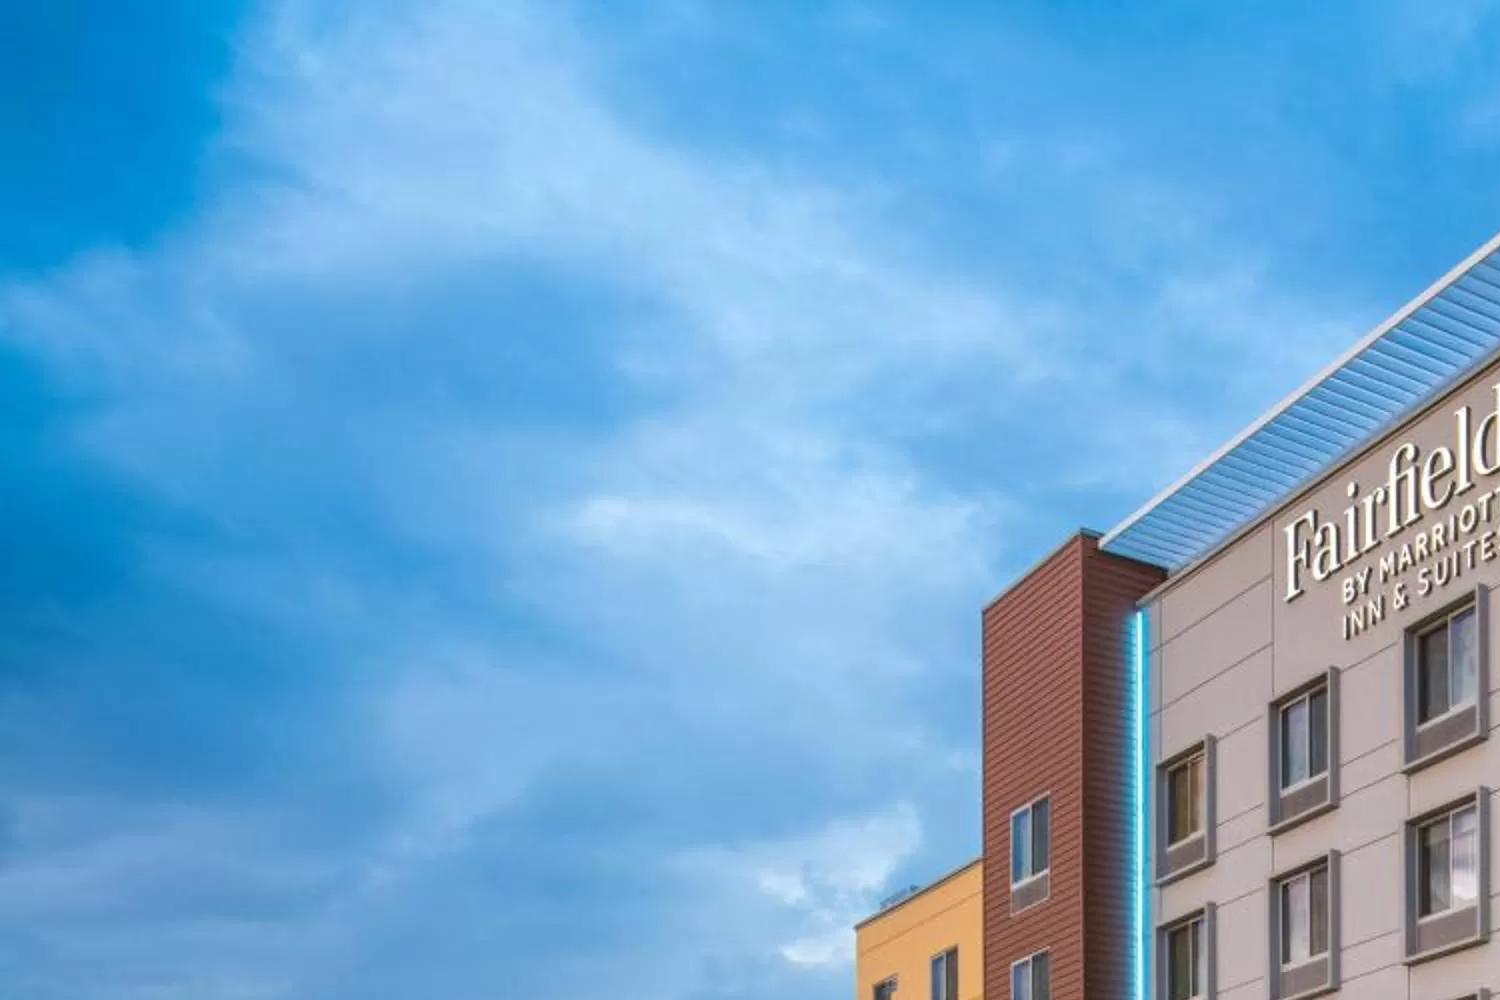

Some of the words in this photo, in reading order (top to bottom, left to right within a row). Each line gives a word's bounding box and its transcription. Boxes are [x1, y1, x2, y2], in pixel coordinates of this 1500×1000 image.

[1343, 567, 1371, 604] BY
[1343, 595, 1385, 639] INN
[1393, 584, 1409, 609] &
